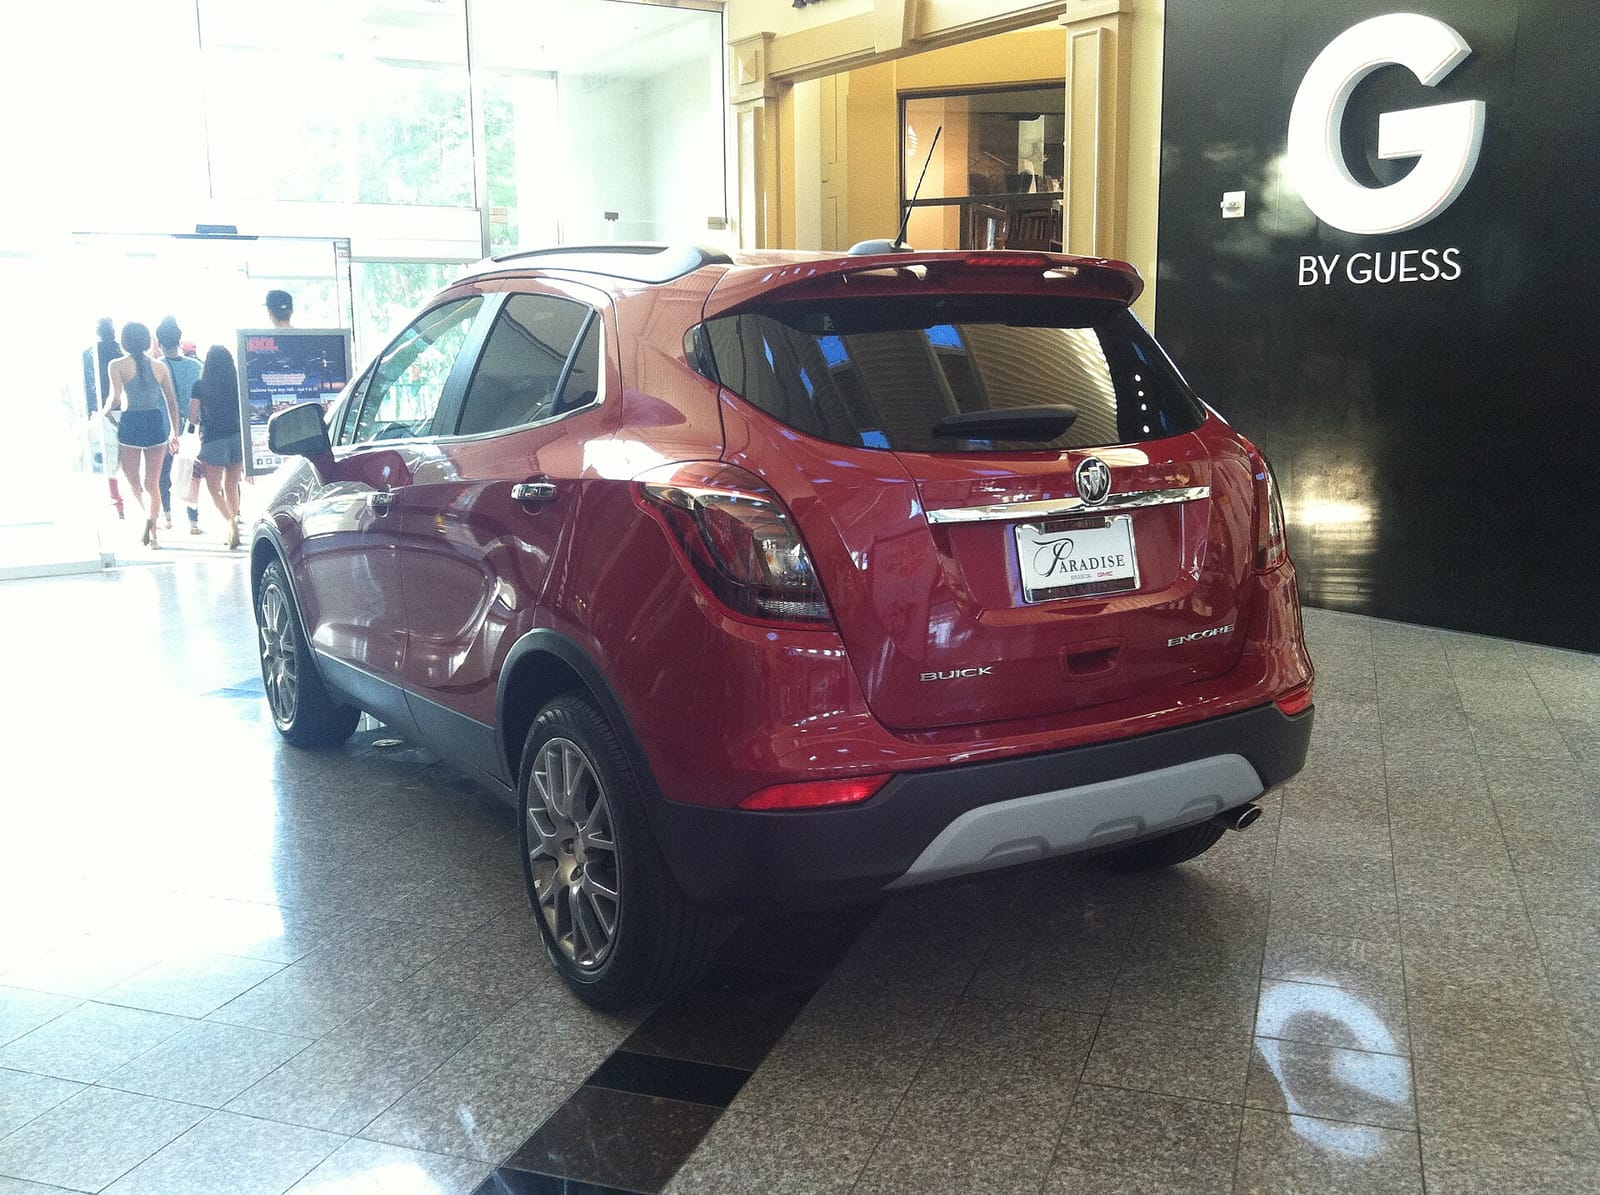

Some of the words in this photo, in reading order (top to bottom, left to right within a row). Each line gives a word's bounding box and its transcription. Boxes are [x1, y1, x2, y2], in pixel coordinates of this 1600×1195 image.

[1287, 12, 1486, 235] G
[1298, 255, 1340, 286] BY
[1346, 247, 1462, 285] GUESS
[1031, 537, 1126, 577] PARADISE
[1096, 570, 1114, 578] GMC
[1166, 623, 1236, 648] ENCORE
[919, 665, 994, 682] BUICK
